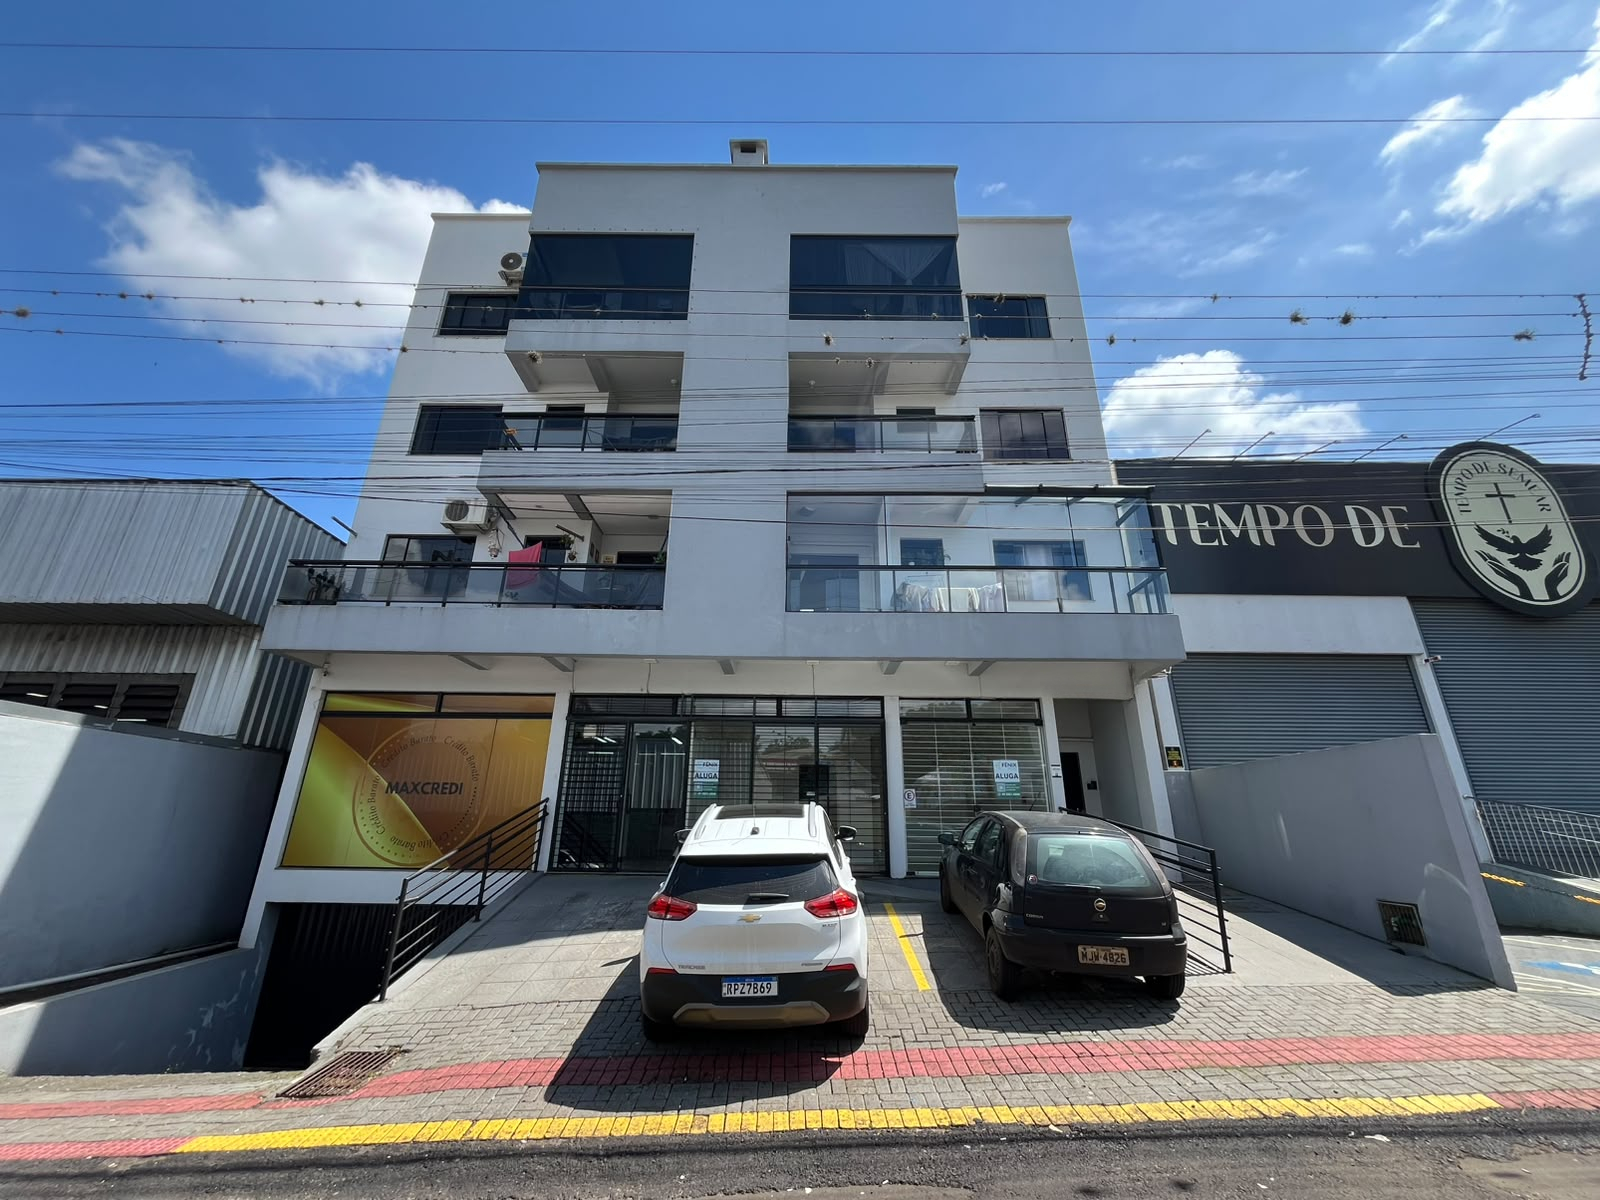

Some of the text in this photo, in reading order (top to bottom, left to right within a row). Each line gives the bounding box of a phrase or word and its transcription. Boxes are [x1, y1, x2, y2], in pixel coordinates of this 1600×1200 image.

[1151, 502, 1421, 548] TEMPO DE
[694, 772, 718, 780] ALUGA
[995, 772, 1019, 780] ALUGA
[385, 782, 464, 795] MAXCREDI
[726, 982, 772, 995] RPZ7B69
